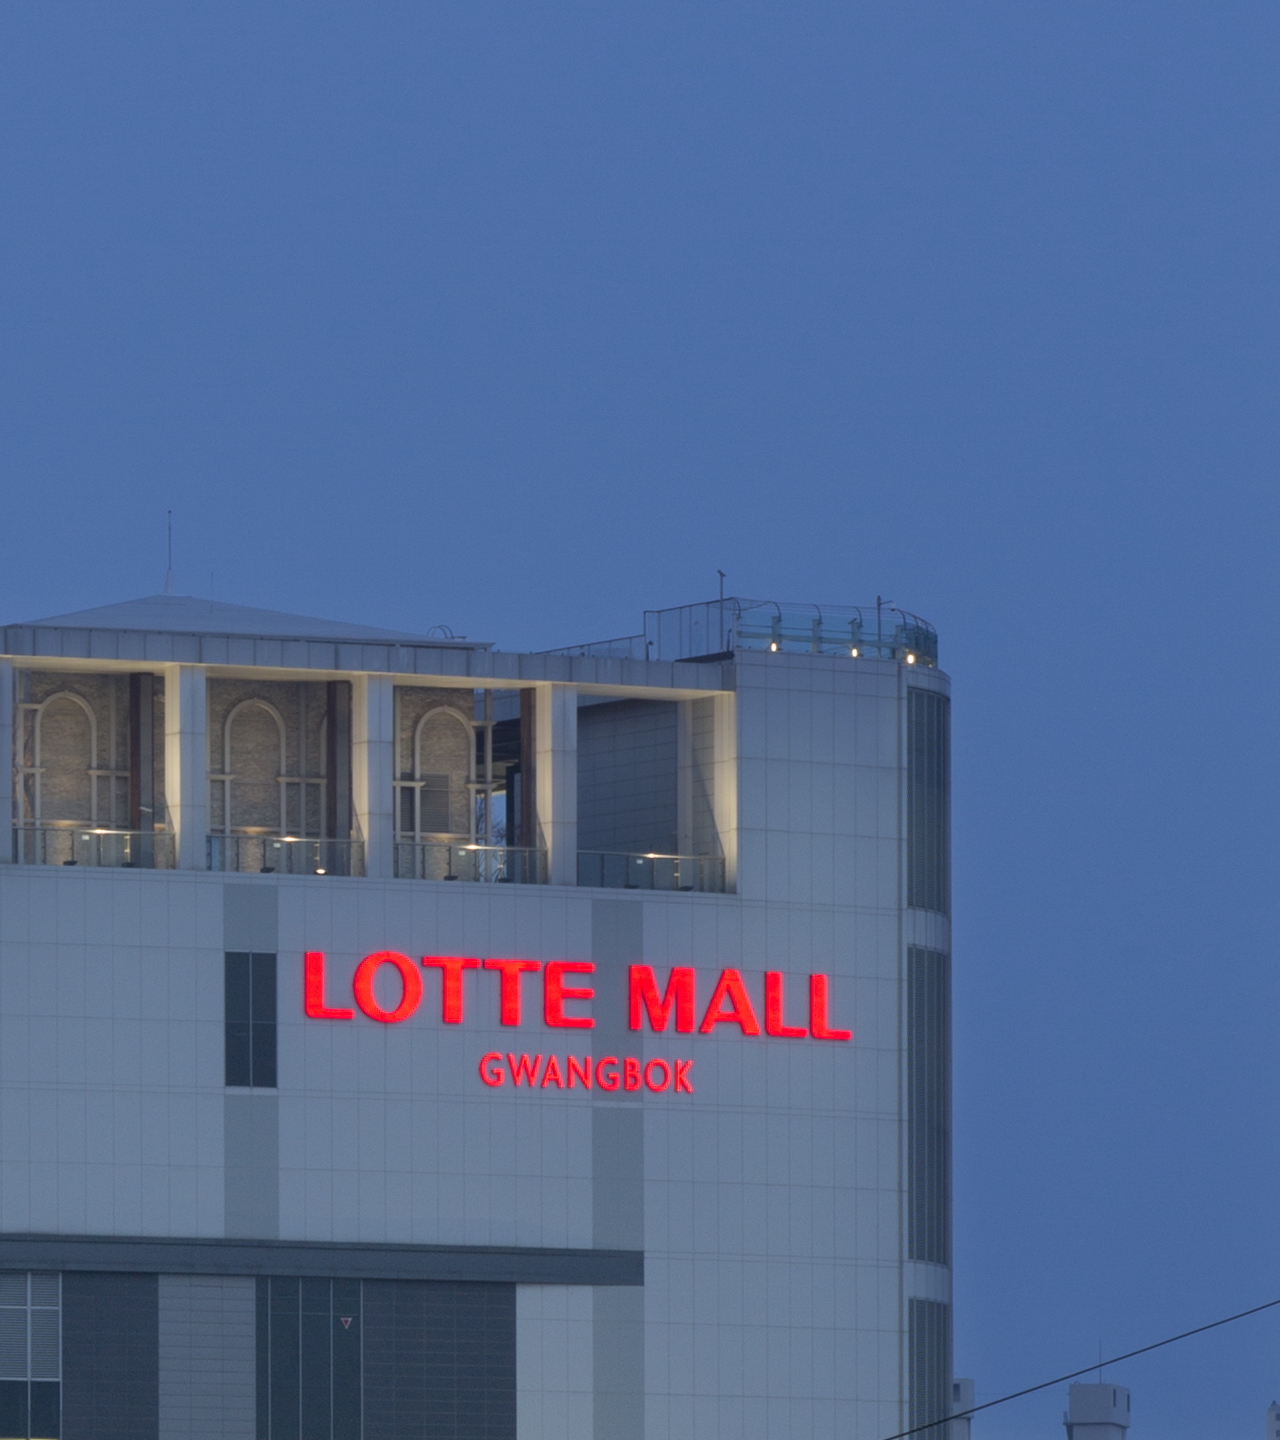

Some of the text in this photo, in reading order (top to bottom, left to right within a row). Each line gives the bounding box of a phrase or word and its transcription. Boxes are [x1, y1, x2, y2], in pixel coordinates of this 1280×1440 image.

[304, 951, 851, 1040] LOTTE MALL
[478, 1052, 694, 1094] GWANGBOK
